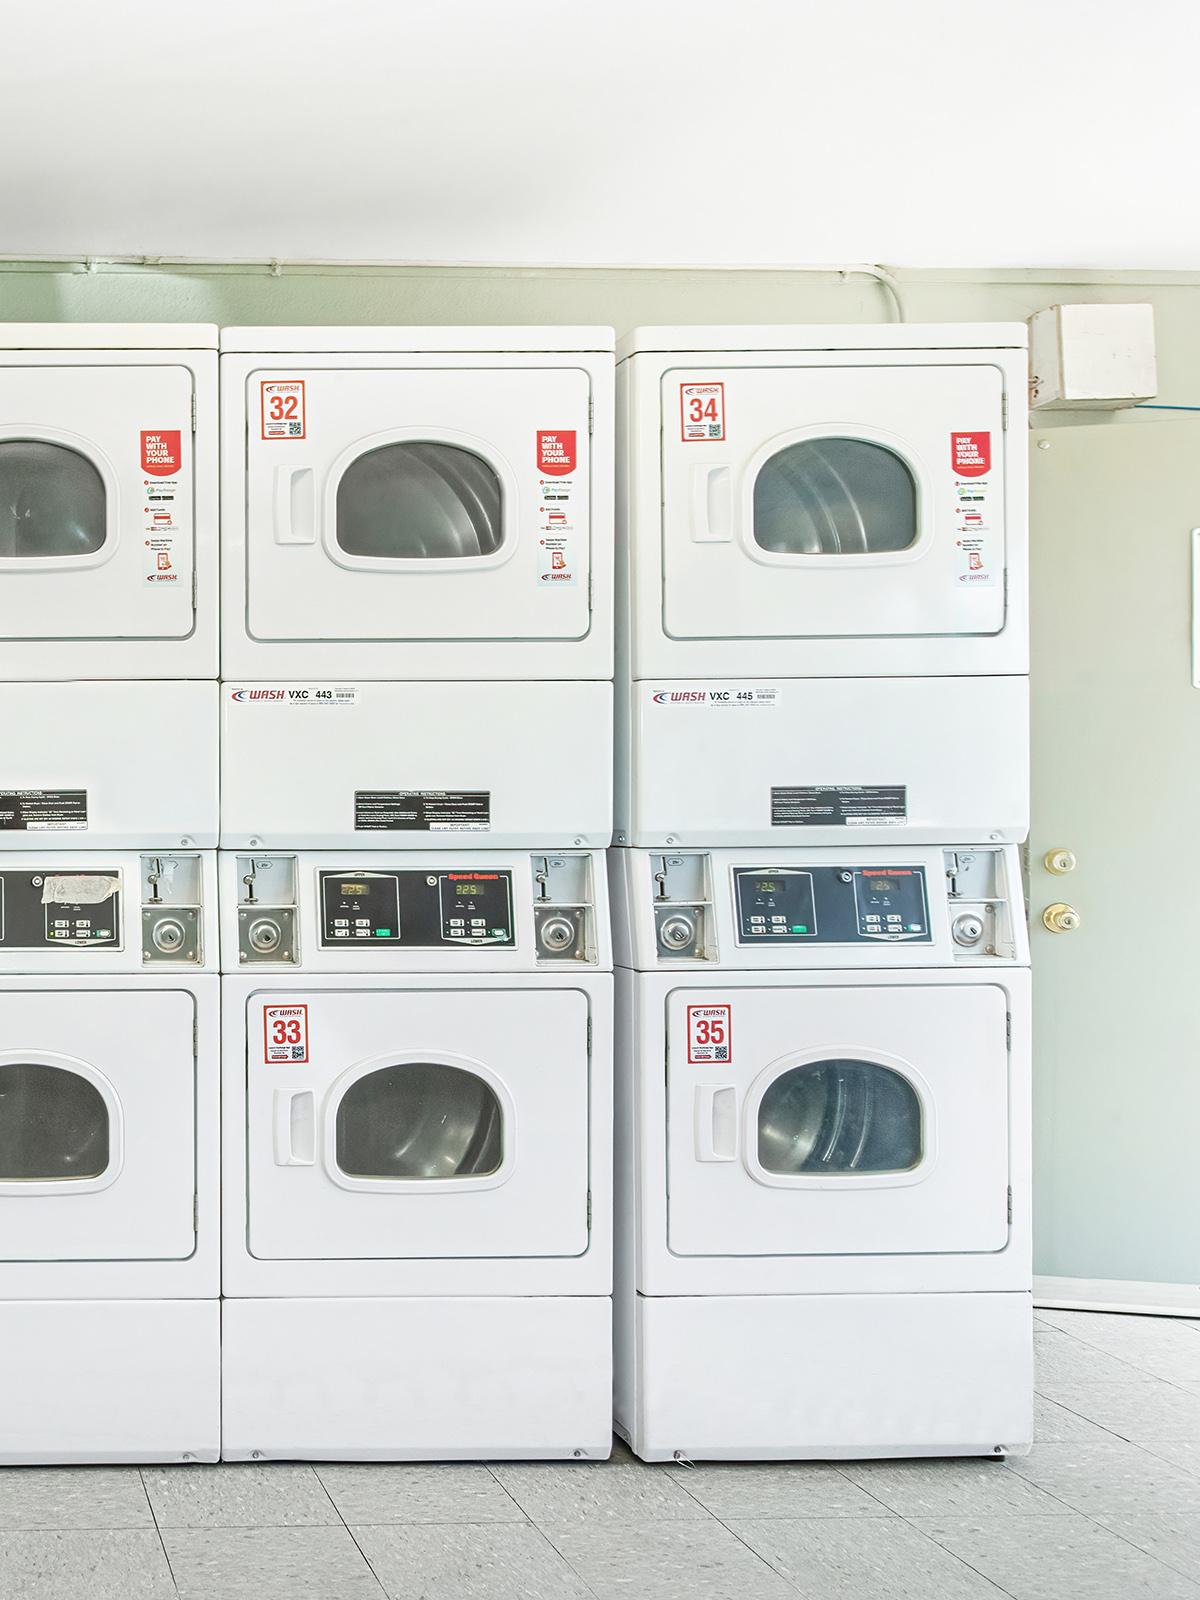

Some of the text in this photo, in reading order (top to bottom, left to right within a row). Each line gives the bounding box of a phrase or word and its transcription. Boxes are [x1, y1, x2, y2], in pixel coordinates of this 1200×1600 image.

[270, 396, 298, 420] 32
[690, 398, 717, 422] 34
[250, 690, 332, 699] WASH VXC 443
[671, 692, 753, 701] WASH VXC 445
[273, 1020, 301, 1044] 33
[696, 1020, 725, 1044] 35
